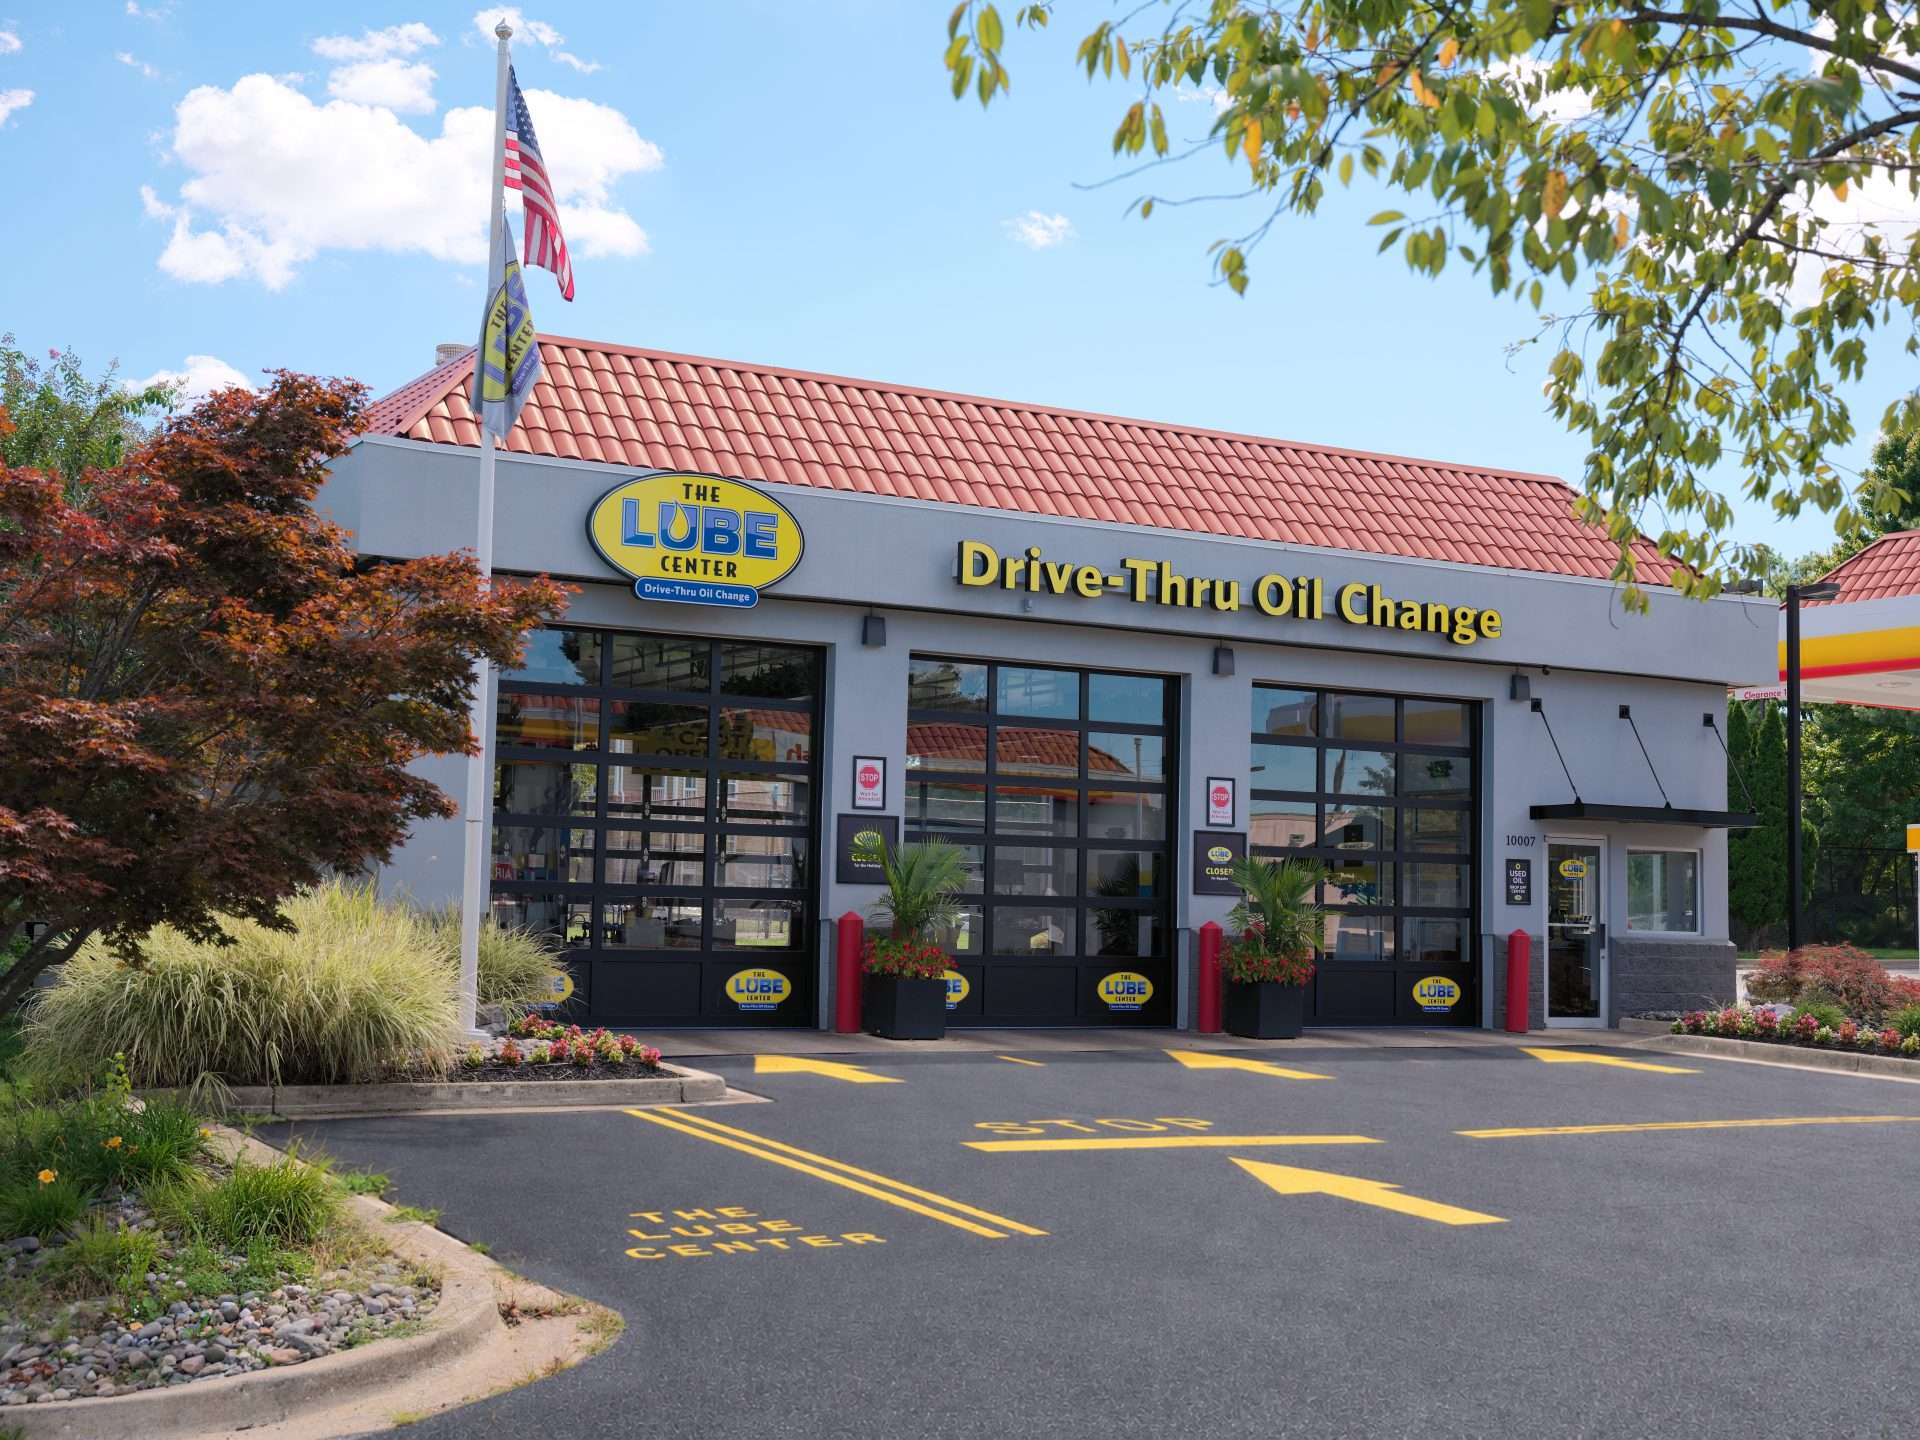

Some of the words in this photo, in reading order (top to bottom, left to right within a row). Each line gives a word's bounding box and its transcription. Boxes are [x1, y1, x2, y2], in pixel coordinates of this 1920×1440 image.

[683, 483, 720, 503] THE
[621, 497, 778, 560] LUBE
[660, 555, 737, 578] CENTER
[644, 583, 696, 597] Drive-Thru
[699, 587, 713, 599] Oil
[715, 590, 750, 603] Change
[957, 540, 1239, 612] Drive-Thru
[1252, 573, 1323, 619] Oil
[1335, 582, 1502, 645] Change
[1743, 690, 1782, 699] Clearance
[861, 773, 879, 782] STOP
[1213, 792, 1229, 801] STOP
[1506, 834, 1536, 847] 10007
[735, 977, 784, 994] LUBE
[1105, 981, 1147, 995] LUBE
[1419, 984, 1455, 998] LUBE
[974, 1117, 1214, 1134] STOP
[629, 1206, 758, 1224] THE
[627, 1219, 803, 1240] LUBE
[624, 1232, 887, 1259] CENTER
